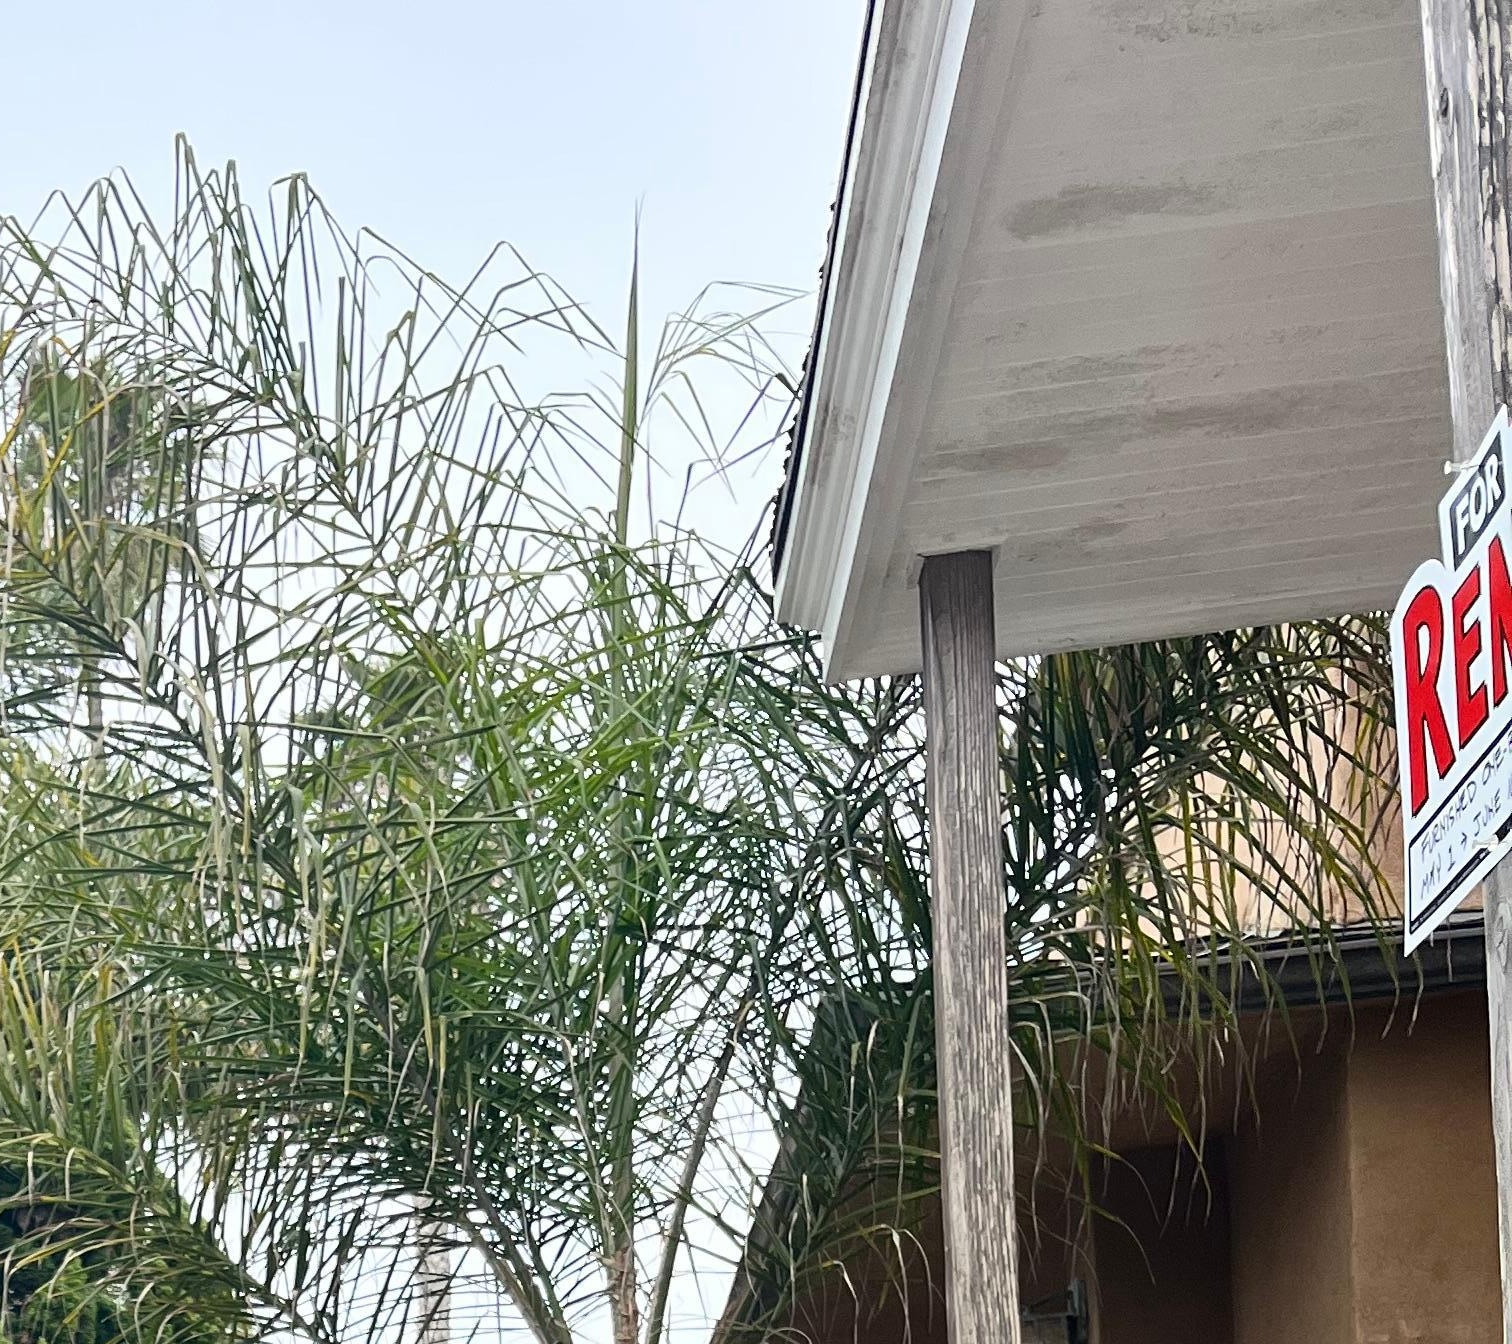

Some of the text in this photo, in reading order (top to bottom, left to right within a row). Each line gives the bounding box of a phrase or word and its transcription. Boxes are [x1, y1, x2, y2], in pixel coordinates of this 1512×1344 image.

[1455, 454, 1502, 556] FOR
[1420, 852, 1441, 900] MAY
[1472, 788, 1501, 838] JUNE
[1421, 780, 1478, 863] FURNISHED
